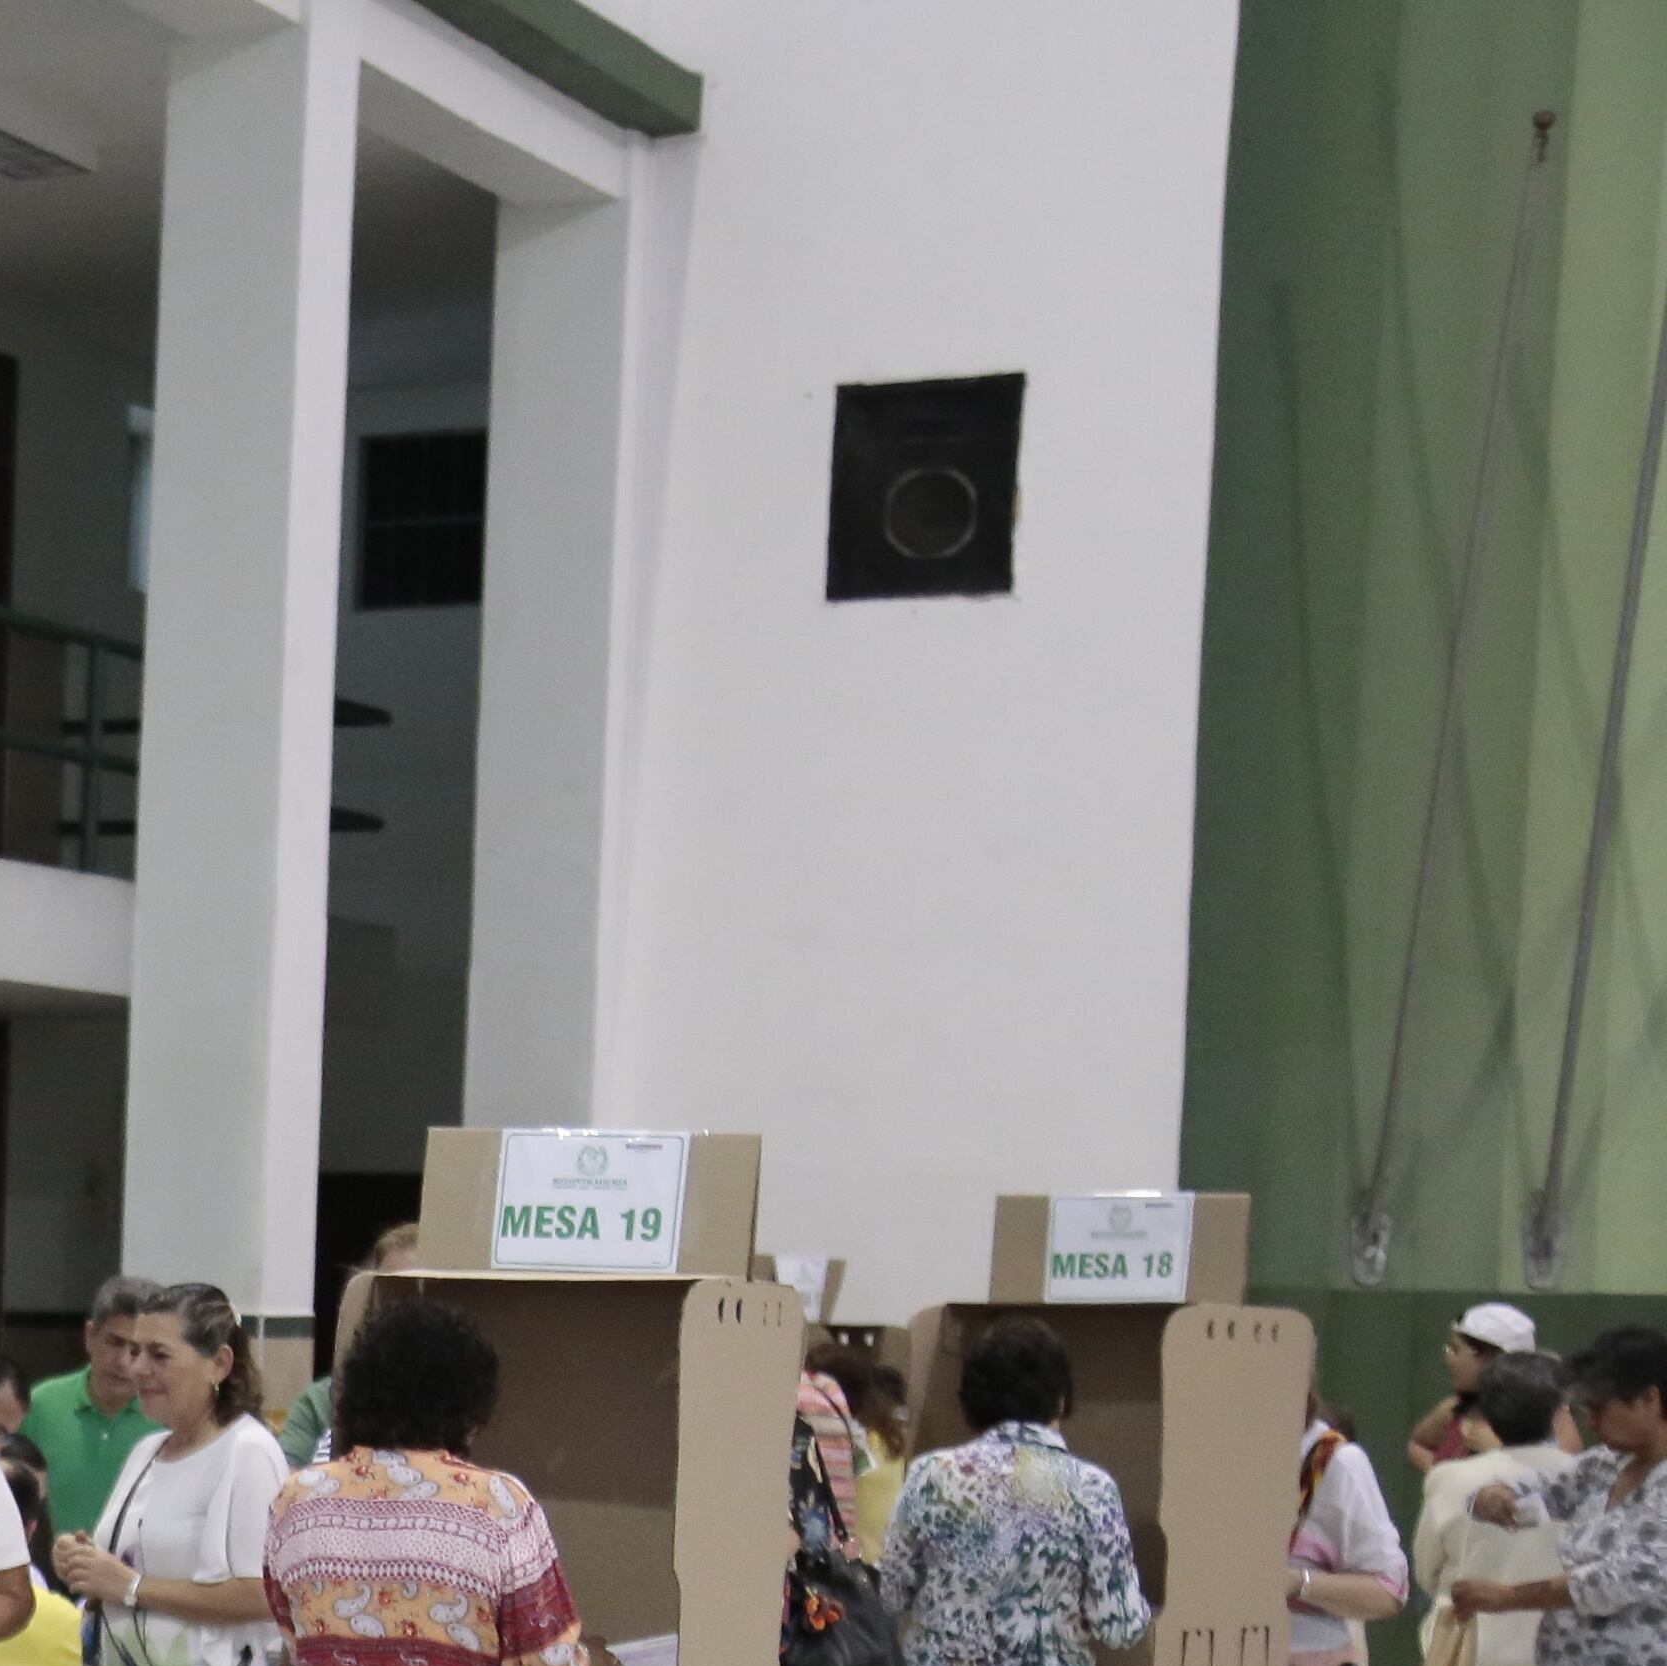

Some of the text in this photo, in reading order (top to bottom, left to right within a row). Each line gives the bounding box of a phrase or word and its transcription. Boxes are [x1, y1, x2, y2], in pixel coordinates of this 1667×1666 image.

[501, 1205, 663, 1242] MESA 19
[1051, 1251, 1174, 1280] MESA 18
